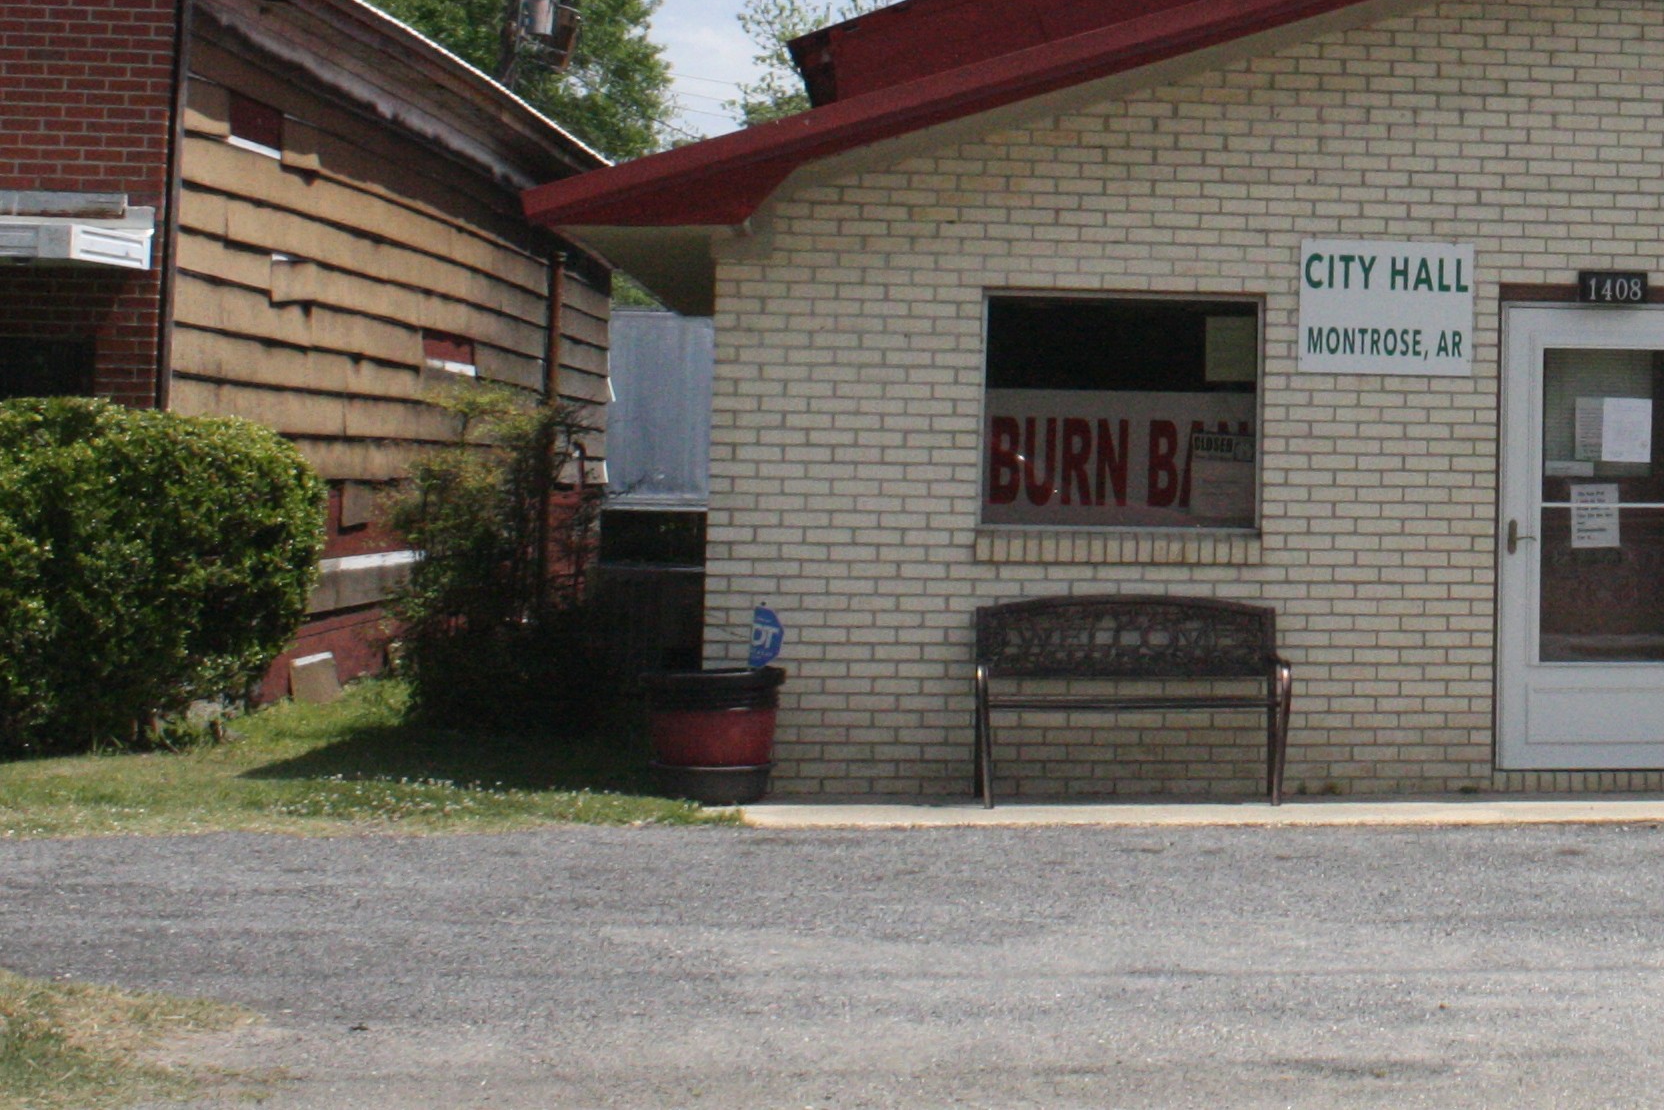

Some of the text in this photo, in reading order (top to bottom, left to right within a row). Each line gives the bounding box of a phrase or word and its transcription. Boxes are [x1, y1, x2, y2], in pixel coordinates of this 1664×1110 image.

[1305, 252, 1469, 293] CITY HALL
[1590, 277, 1642, 301] 1408
[1307, 326, 1463, 361] MONTROSE, AR
[989, 414, 1130, 507] BURN
